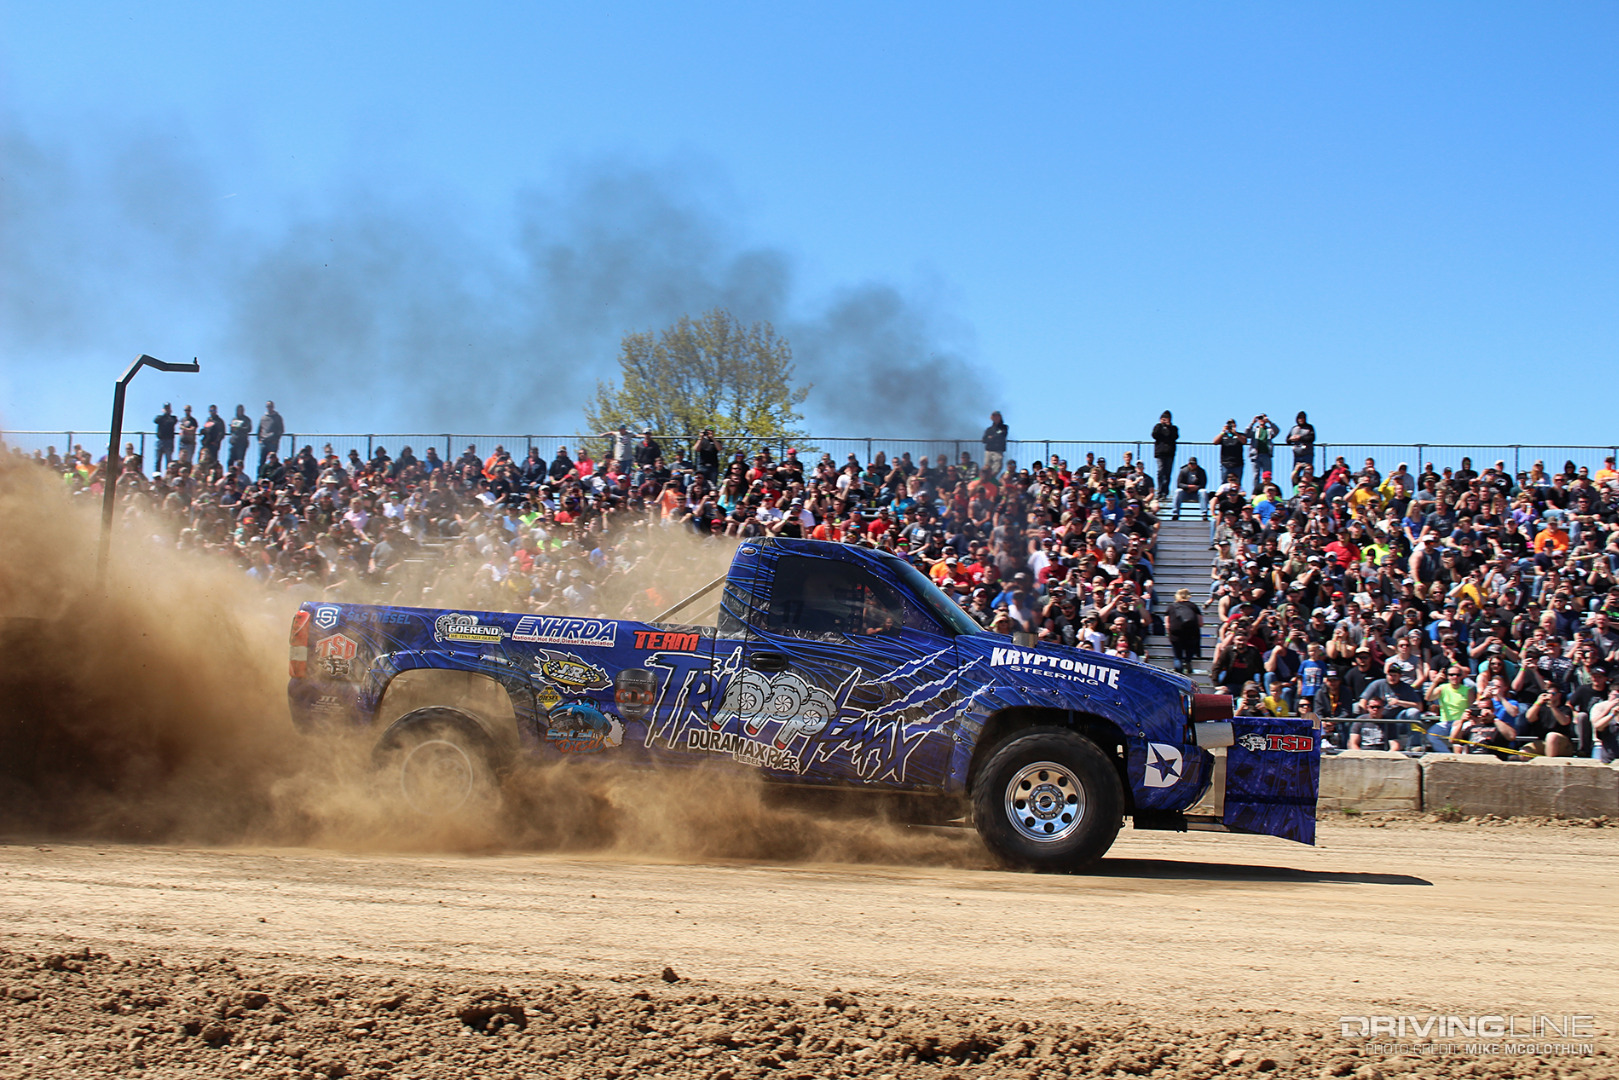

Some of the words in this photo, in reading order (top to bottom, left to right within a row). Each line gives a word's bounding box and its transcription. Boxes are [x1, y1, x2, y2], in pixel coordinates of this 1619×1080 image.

[370, 612, 411, 625] DIESEL
[448, 625, 500, 636] GOEREND
[528, 617, 618, 642] NHRDA
[317, 635, 357, 661] TSD
[512, 634, 537, 643] National
[561, 639, 579, 647] Diesel
[580, 640, 614, 648] Association
[633, 630, 700, 652] TEAM
[989, 646, 1121, 691] KRYPTONITE
[1009, 665, 1099, 686] STEERING
[687, 729, 768, 762] DURAMAX
[1267, 735, 1313, 751] TSD
